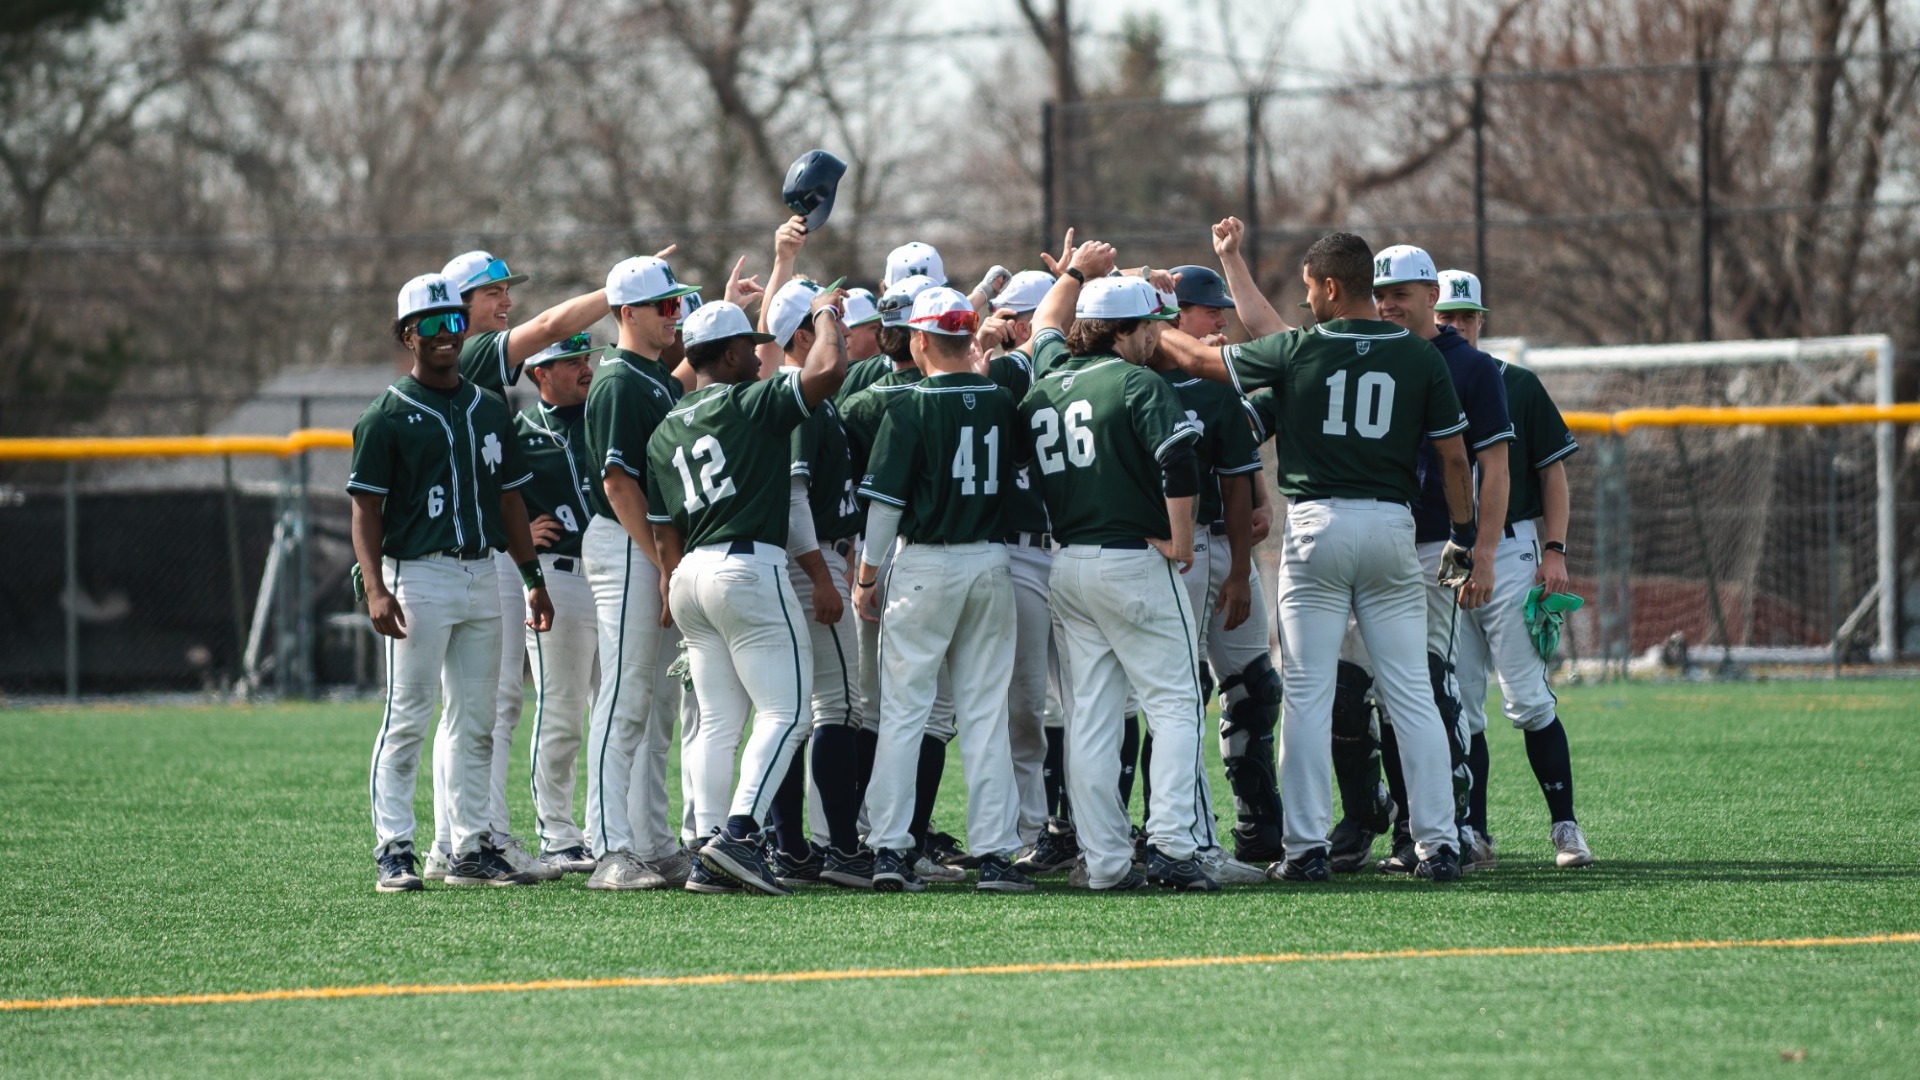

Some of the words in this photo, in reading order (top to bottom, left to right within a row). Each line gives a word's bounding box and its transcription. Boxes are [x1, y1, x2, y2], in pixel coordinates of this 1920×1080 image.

[427, 282, 450, 303] M
[1376, 258, 1391, 278] M
[1450, 279, 1471, 298] M
[1323, 369, 1395, 439] 10
[952, 425, 999, 495] 41
[1031, 399, 1096, 475] 26
[672, 434, 737, 515] 12
[427, 484, 445, 519] 6
